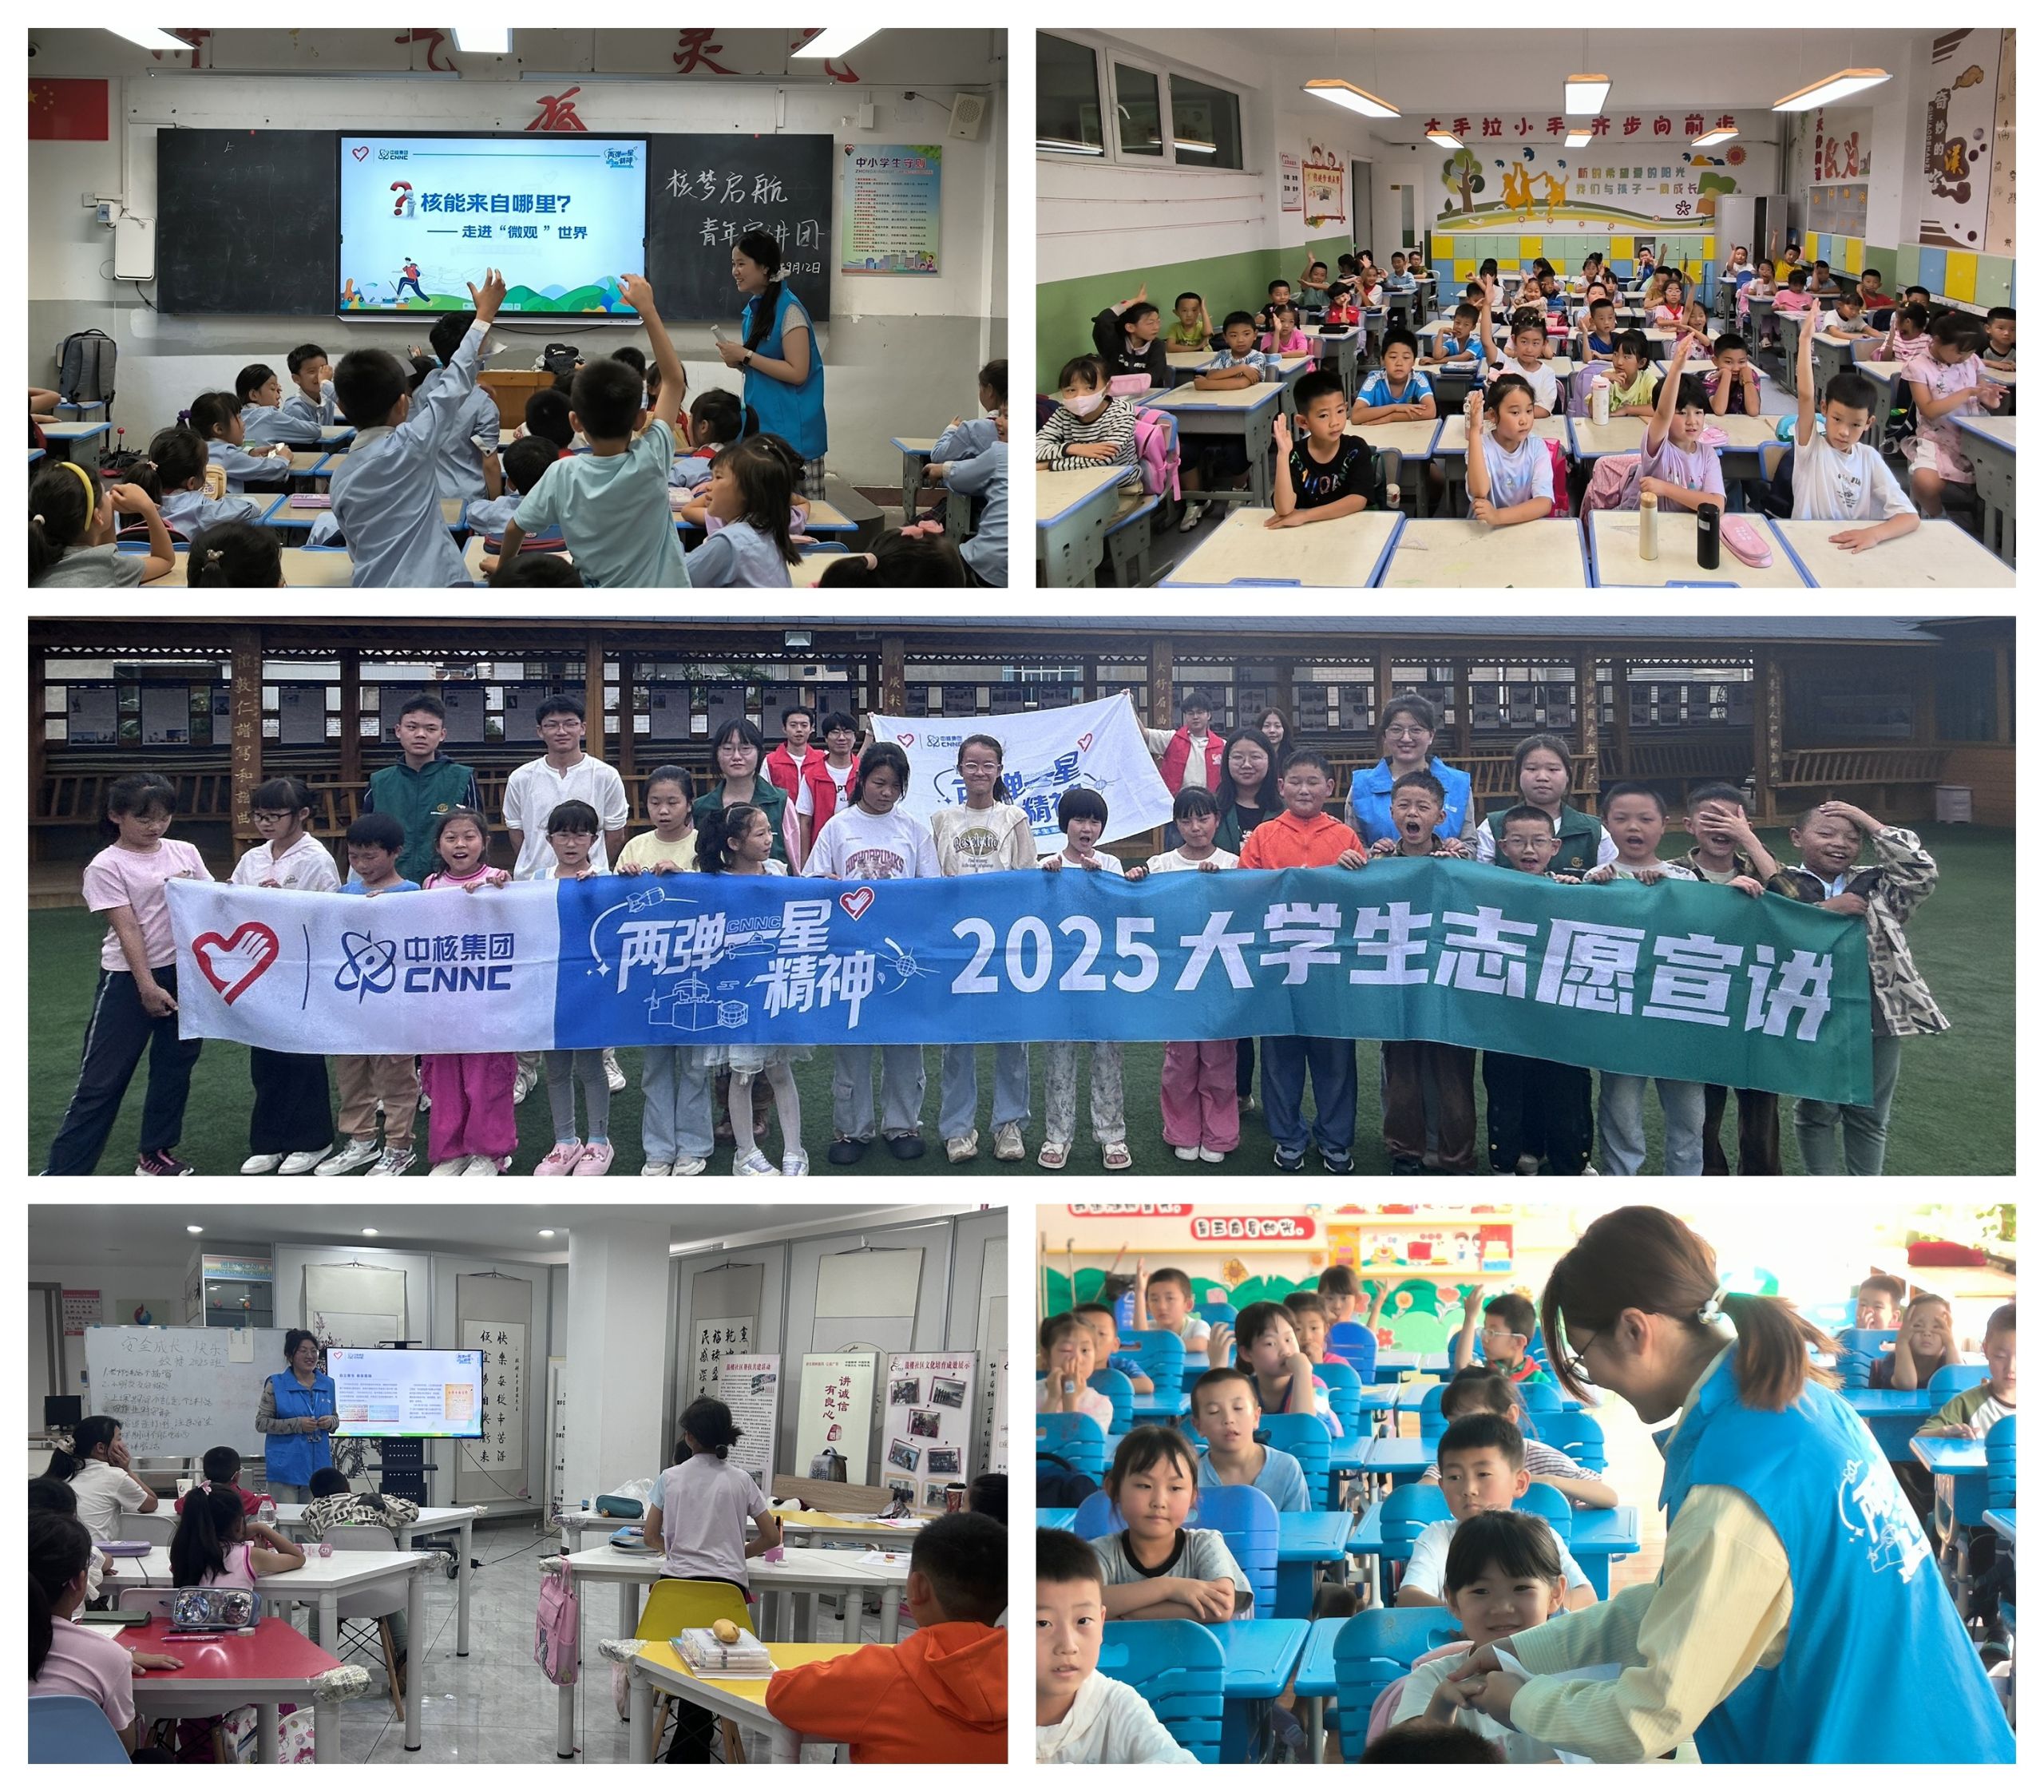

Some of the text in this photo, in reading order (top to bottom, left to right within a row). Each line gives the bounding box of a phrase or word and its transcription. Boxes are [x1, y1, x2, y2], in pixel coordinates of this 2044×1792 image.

[1424, 117, 1565, 137] 大手拉小手
[856, 157, 926, 168] 中小学生守则
[1577, 166, 1686, 180] 新的希望爱的阳光
[665, 169, 789, 204] 核梦启航
[1575, 183, 1698, 196] 我们与孩子一同成长
[421, 193, 572, 213] 核能来自哪里?
[727, 915, 782, 934] CNNC
[404, 933, 515, 962] 中核集团
[616, 898, 834, 993] 两弹一星
[404, 965, 513, 993] CNNC
[746, 950, 876, 1029] 精神
[822, 1385, 838, 1421] 有良心
[838, 1376, 852, 1412] 讲诚信
